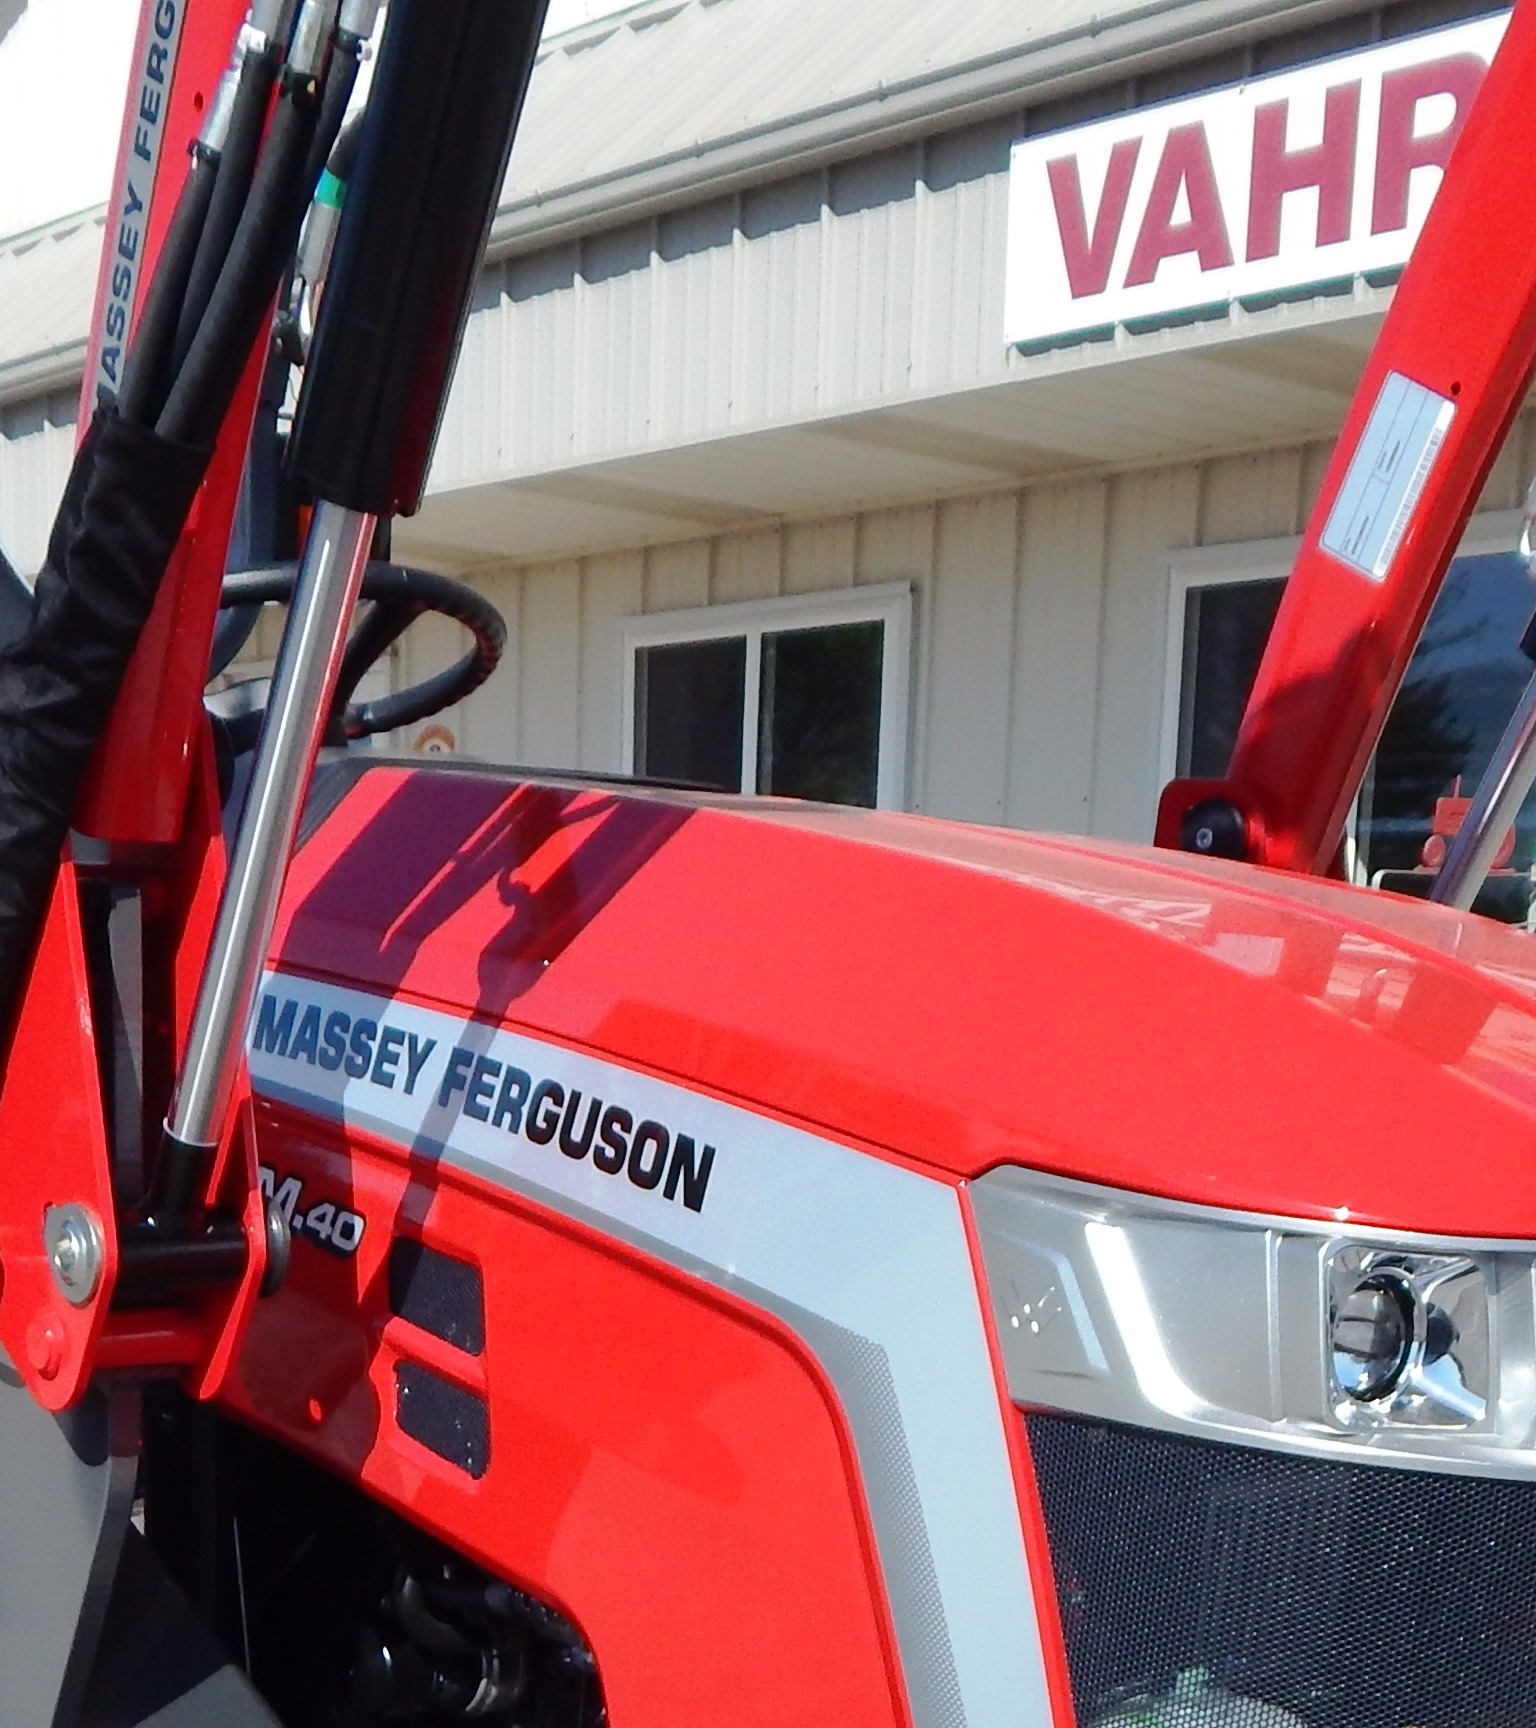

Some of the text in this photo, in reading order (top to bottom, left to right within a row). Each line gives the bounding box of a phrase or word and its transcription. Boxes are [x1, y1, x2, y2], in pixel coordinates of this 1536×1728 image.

[98, 189, 144, 399] ASSEY
[253, 995, 716, 1213] MASSEY FERGUSON
